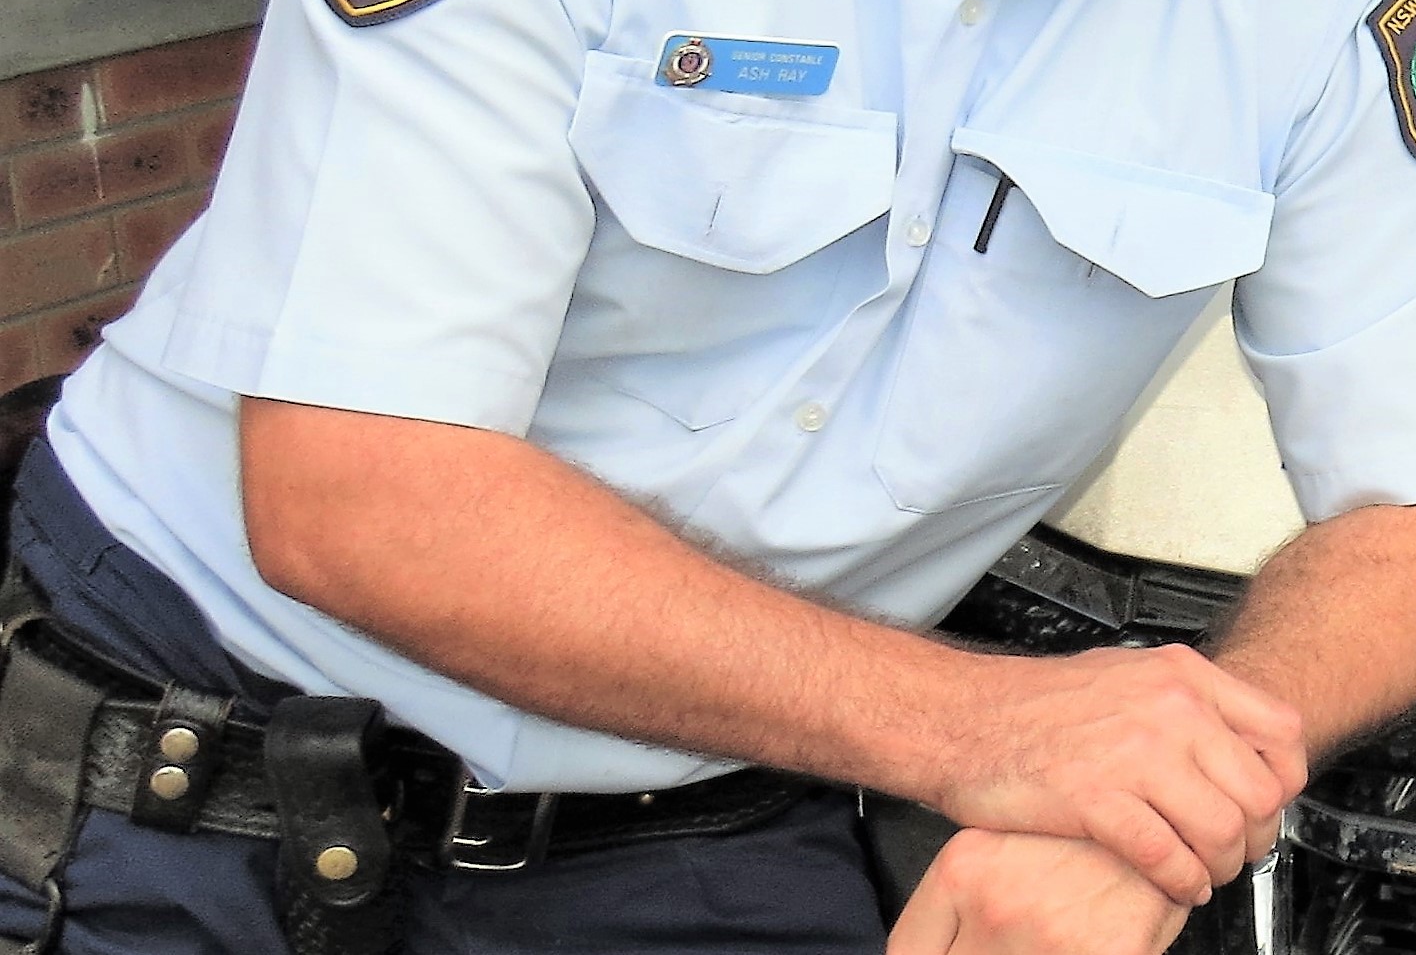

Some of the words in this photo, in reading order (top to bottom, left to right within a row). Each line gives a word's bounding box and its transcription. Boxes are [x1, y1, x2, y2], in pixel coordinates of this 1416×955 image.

[770, 52, 824, 66] CONSTABLE
[737, 66, 770, 82] ASH
[777, 68, 808, 83] RAY
